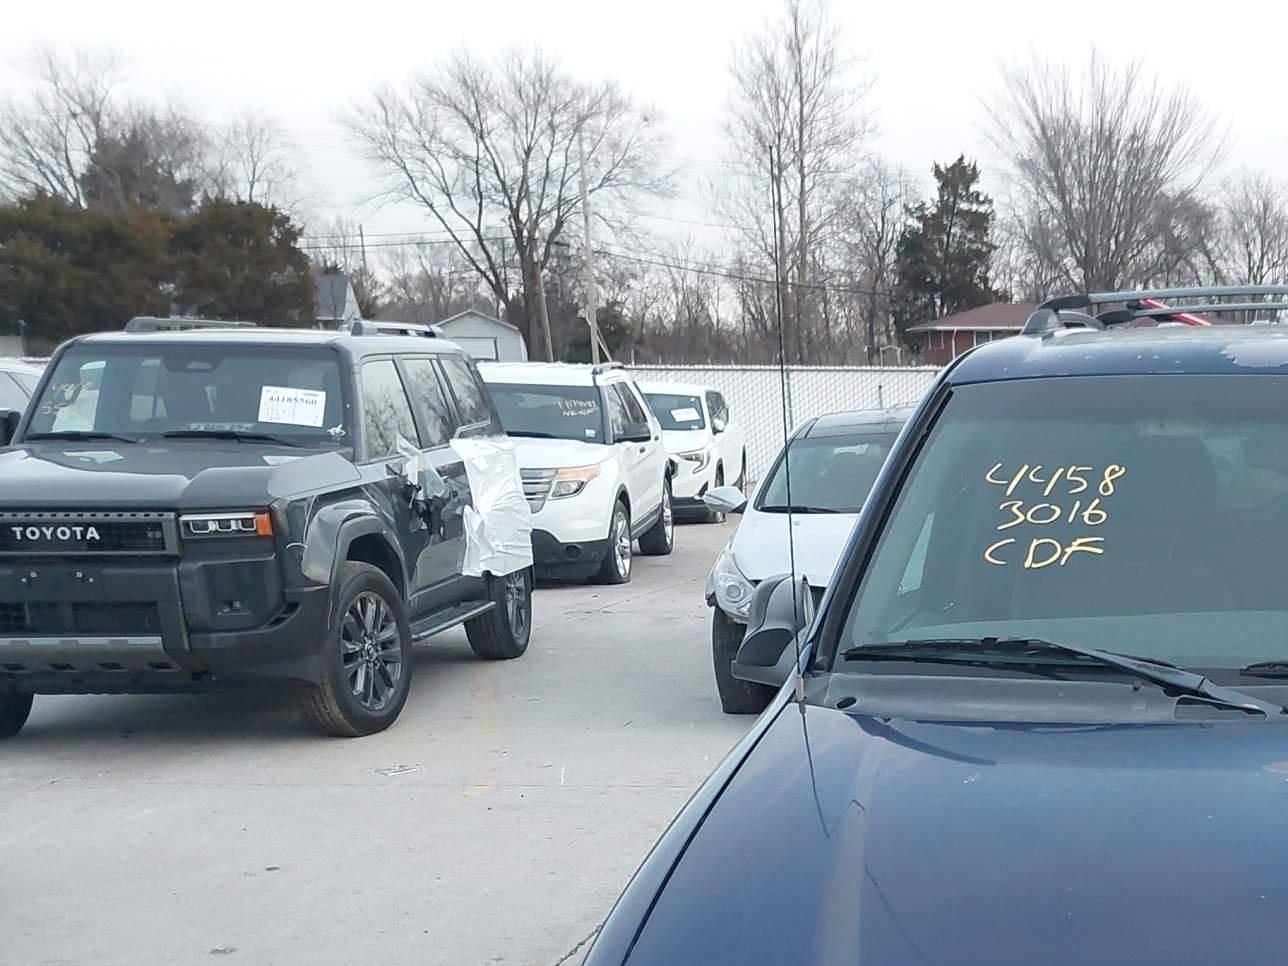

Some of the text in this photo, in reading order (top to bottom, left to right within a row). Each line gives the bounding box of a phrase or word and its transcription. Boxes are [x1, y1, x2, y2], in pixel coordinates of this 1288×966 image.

[985, 462, 1126, 497] 4458
[996, 498, 1108, 531] 3016
[11, 526, 101, 541] TOYOTA
[983, 537, 1105, 569] CDF
